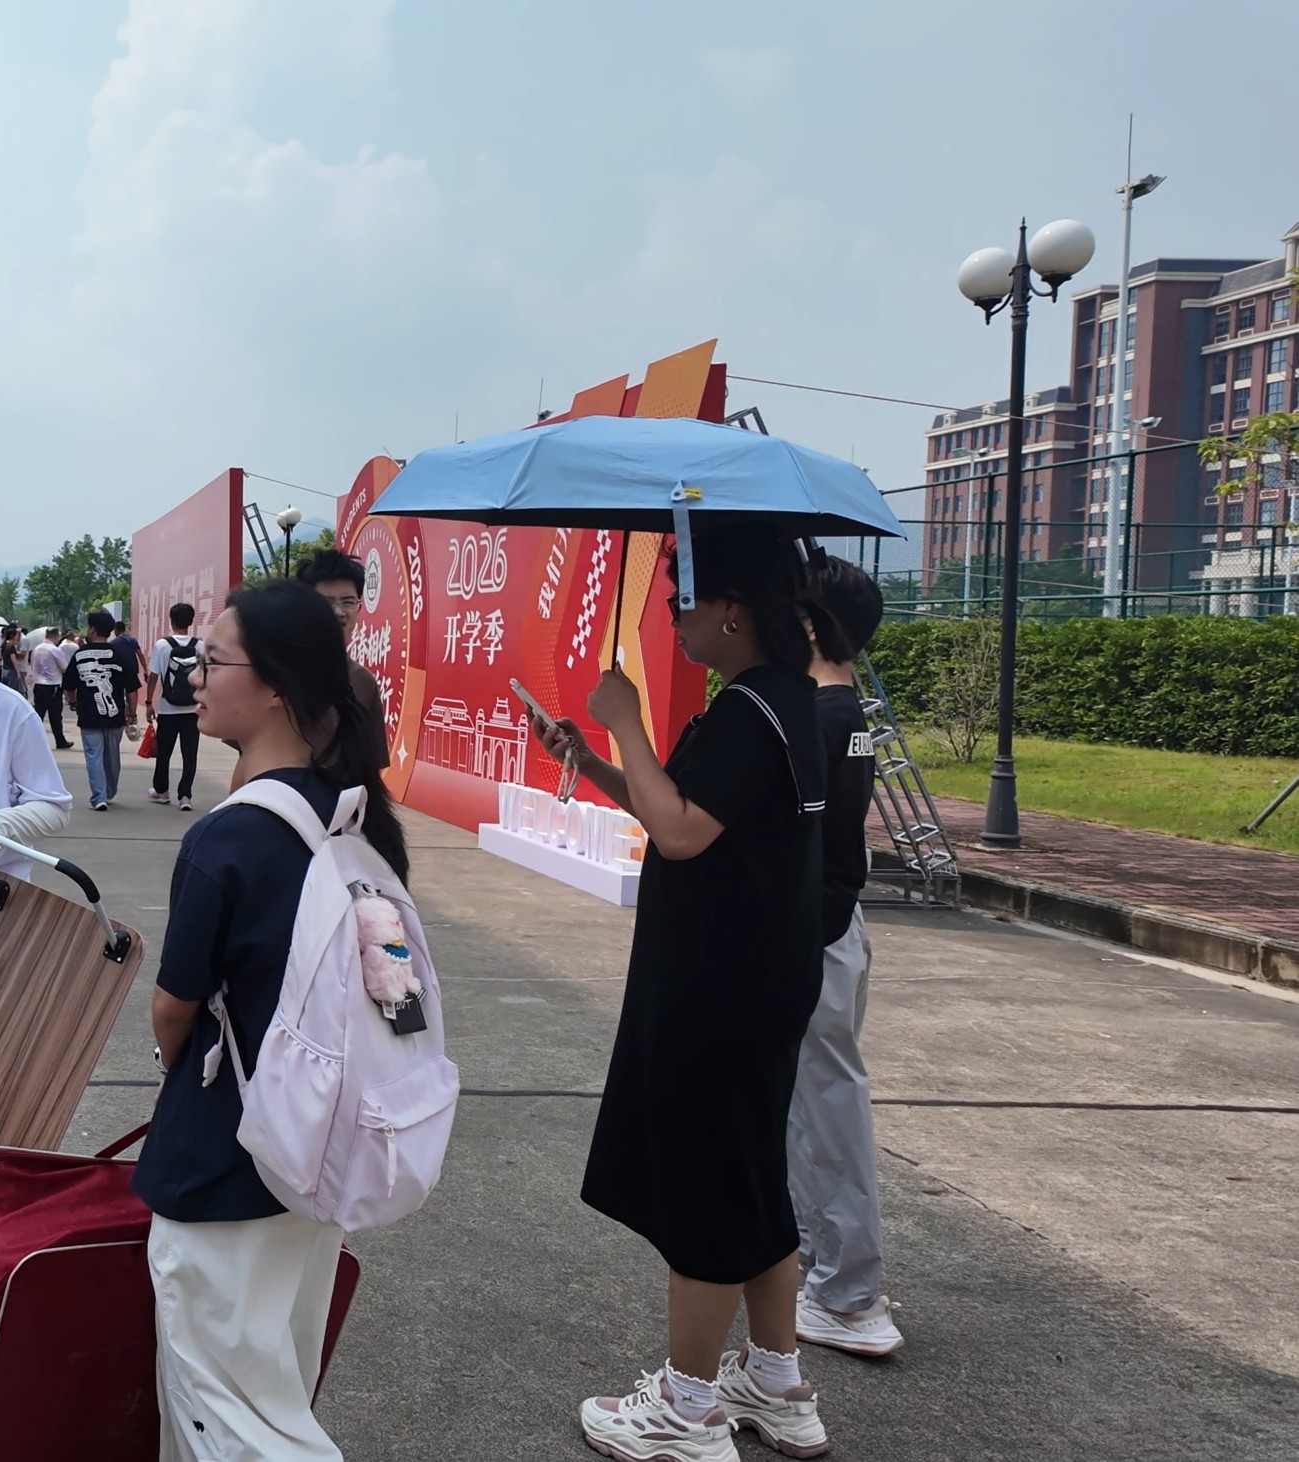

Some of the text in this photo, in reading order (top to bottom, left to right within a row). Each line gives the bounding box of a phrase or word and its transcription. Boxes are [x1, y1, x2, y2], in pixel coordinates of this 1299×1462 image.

[341, 488, 366, 548] STUDENTS
[407, 536, 423, 621] 2026
[447, 527, 508, 600] 2026
[346, 619, 392, 672] 青春相伴
[442, 608, 504, 666] 开学季
[499, 782, 648, 873] WELCOME
